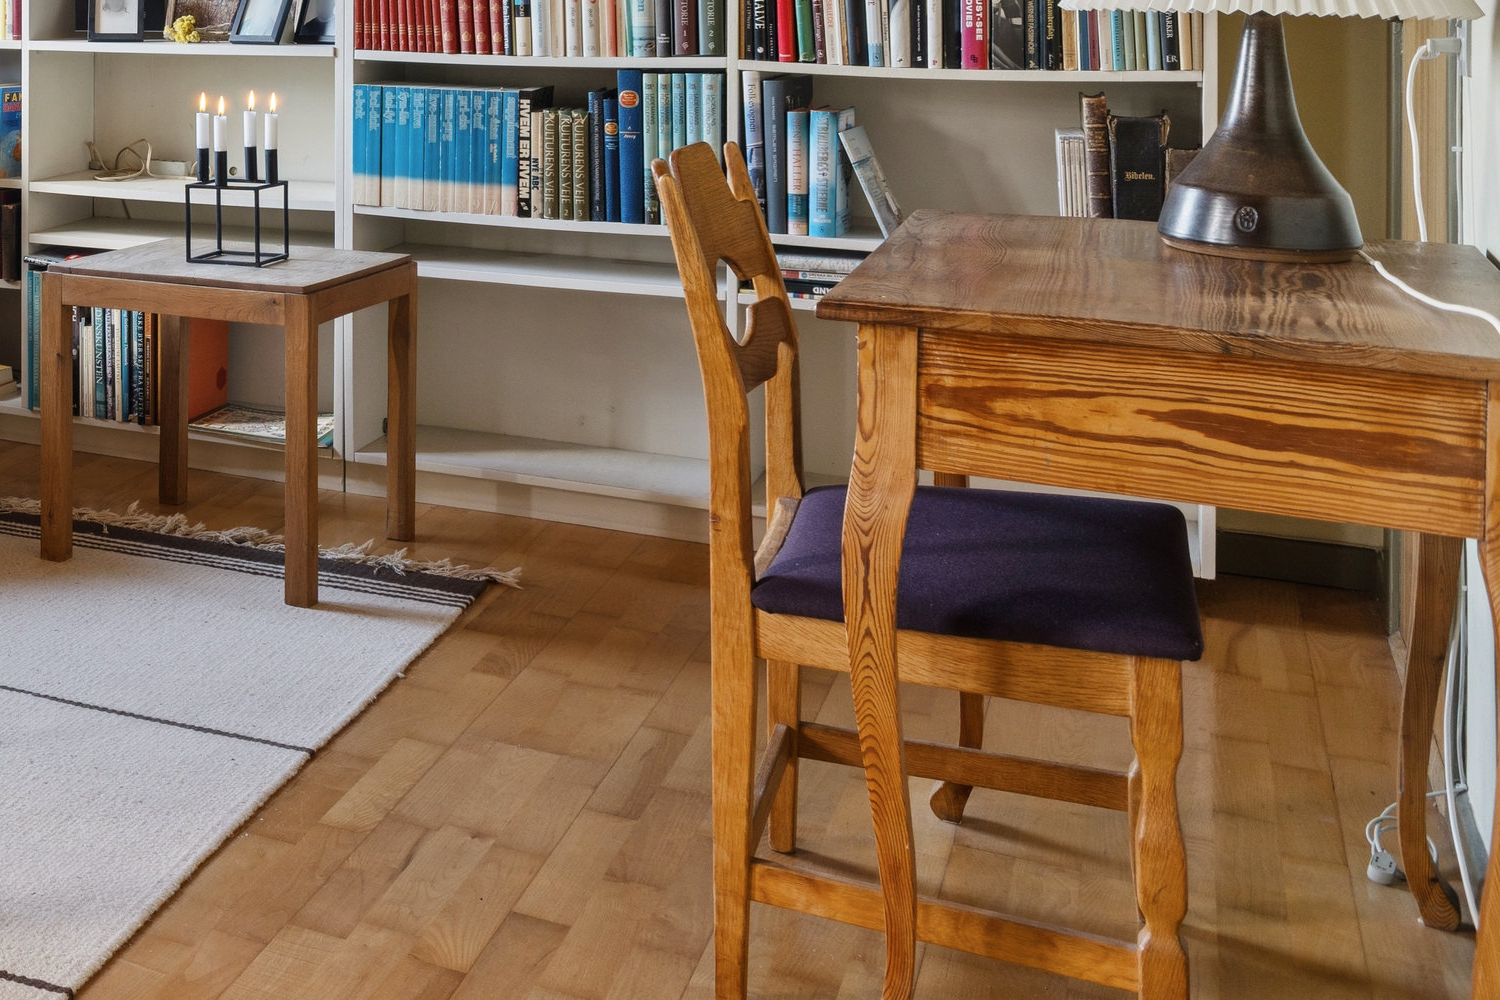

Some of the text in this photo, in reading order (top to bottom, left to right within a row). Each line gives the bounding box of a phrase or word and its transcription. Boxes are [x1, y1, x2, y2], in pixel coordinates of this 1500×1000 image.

[1027, 0, 1036, 22] WERNER
[1165, 12, 1175, 39] PARKER
[708, 29, 715, 38] 2
[1028, 22, 1036, 55] FASSBINDER
[505, 97, 518, 159] supplement
[748, 83, 757, 133] Folkevognen
[519, 99, 531, 199] HVEM ER HVEM
[544, 116, 555, 177] KULTURENS
[560, 118, 571, 178] KULTURENS
[574, 118, 585, 179] KULTURENS
[792, 117, 803, 191] BENT HALLER
[816, 116, 830, 213] STRINDBERGS STJERNE
[532, 157, 540, 191] NYE ABC
[544, 180, 555, 203] VEJE
[560, 181, 571, 204] VEJE
[574, 182, 585, 205] VEJE
